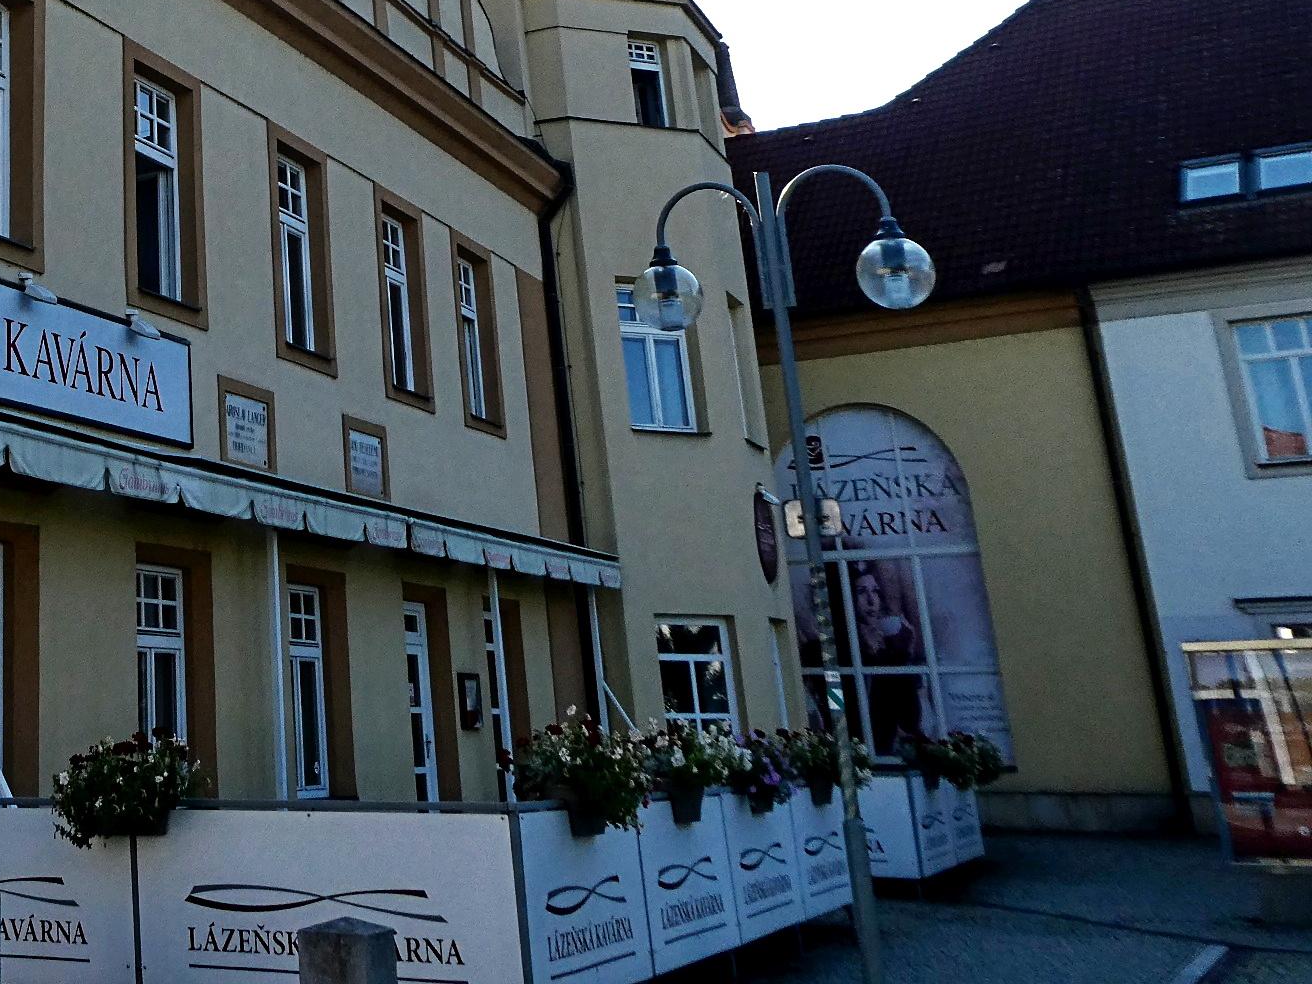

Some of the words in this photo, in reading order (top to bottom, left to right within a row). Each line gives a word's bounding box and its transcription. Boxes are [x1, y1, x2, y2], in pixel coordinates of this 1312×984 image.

[2, 316, 165, 412] KAVÁRNA
[842, 509, 948, 536] VÁRNA
[0, 914, 89, 944] AVÁRNA
[188, 922, 300, 955] LÁZEŇSK
